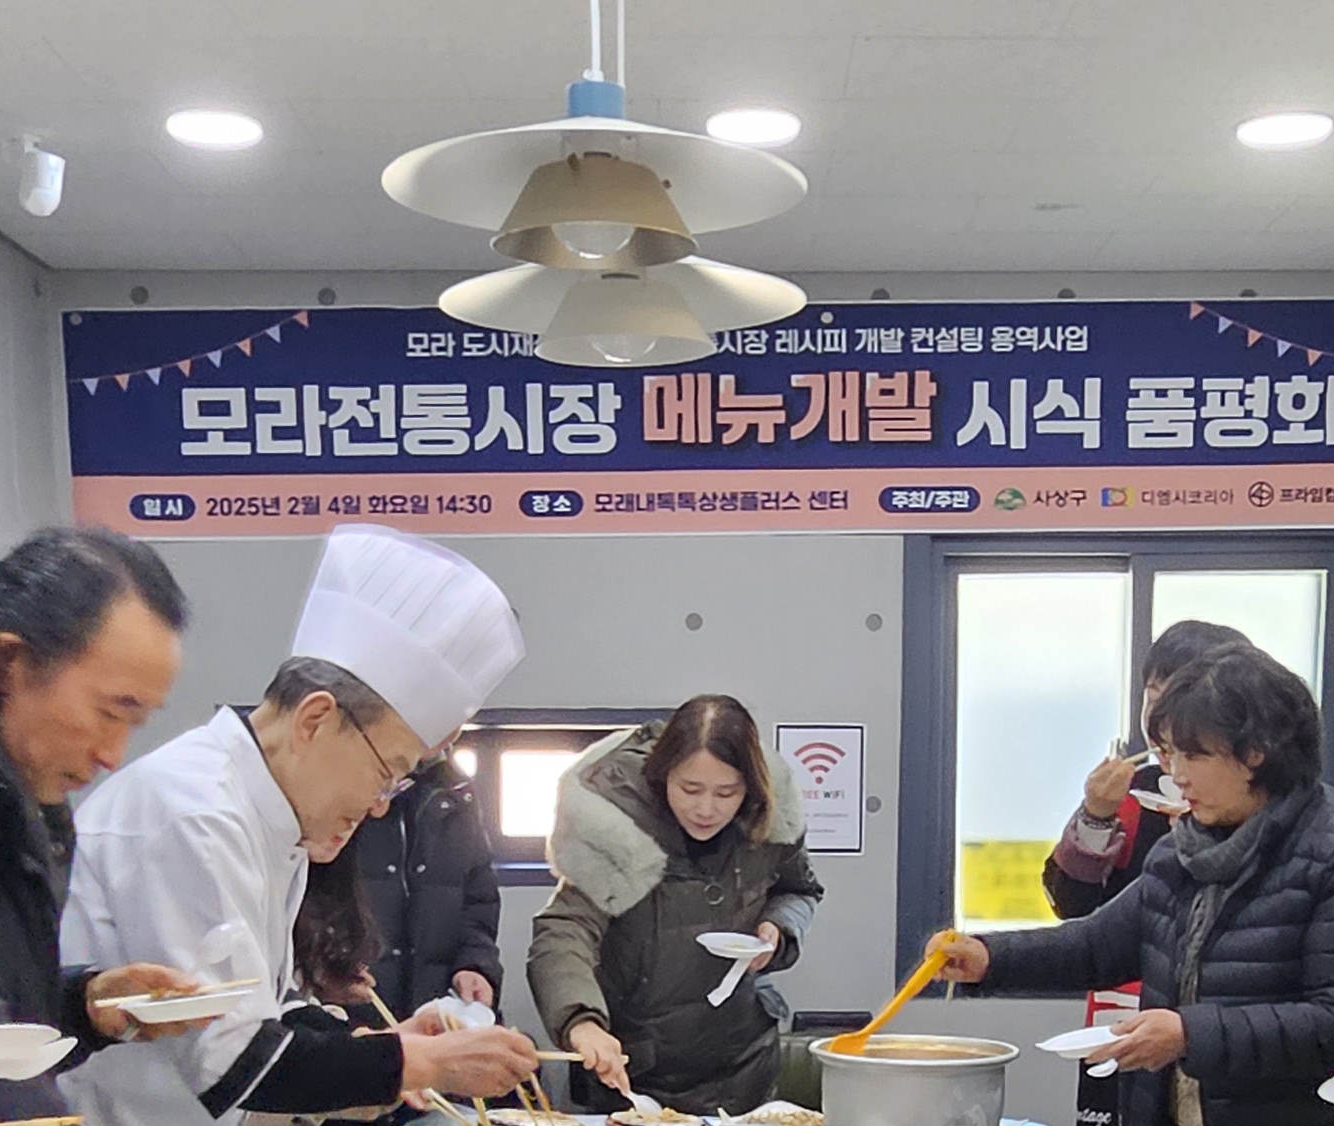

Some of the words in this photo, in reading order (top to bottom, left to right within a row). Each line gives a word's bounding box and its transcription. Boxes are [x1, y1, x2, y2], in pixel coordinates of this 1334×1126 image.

[406, 332, 456, 358] 모라
[461, 332, 540, 358] 도시재
[709, 329, 769, 356] 시장
[775, 328, 847, 354] 레시피
[854, 327, 905, 354] 개발
[910, 326, 983, 353] 컨설팅
[990, 326, 1089, 352] 용역사업
[180, 383, 622, 456] 모라전통시장
[643, 370, 937, 444] 메뉴개발
[956, 377, 1102, 450] 시식
[205, 497, 281, 517] 2025년
[287, 496, 321, 516] 2월
[327, 496, 361, 515] 4일
[368, 495, 430, 515] 화요일
[436, 495, 493, 514] 14:30
[531, 495, 572, 513] 장소
[807, 490, 849, 511] 센터
[891, 490, 971, 509] 주최/주관
[1033, 489, 1088, 508] 사상구
